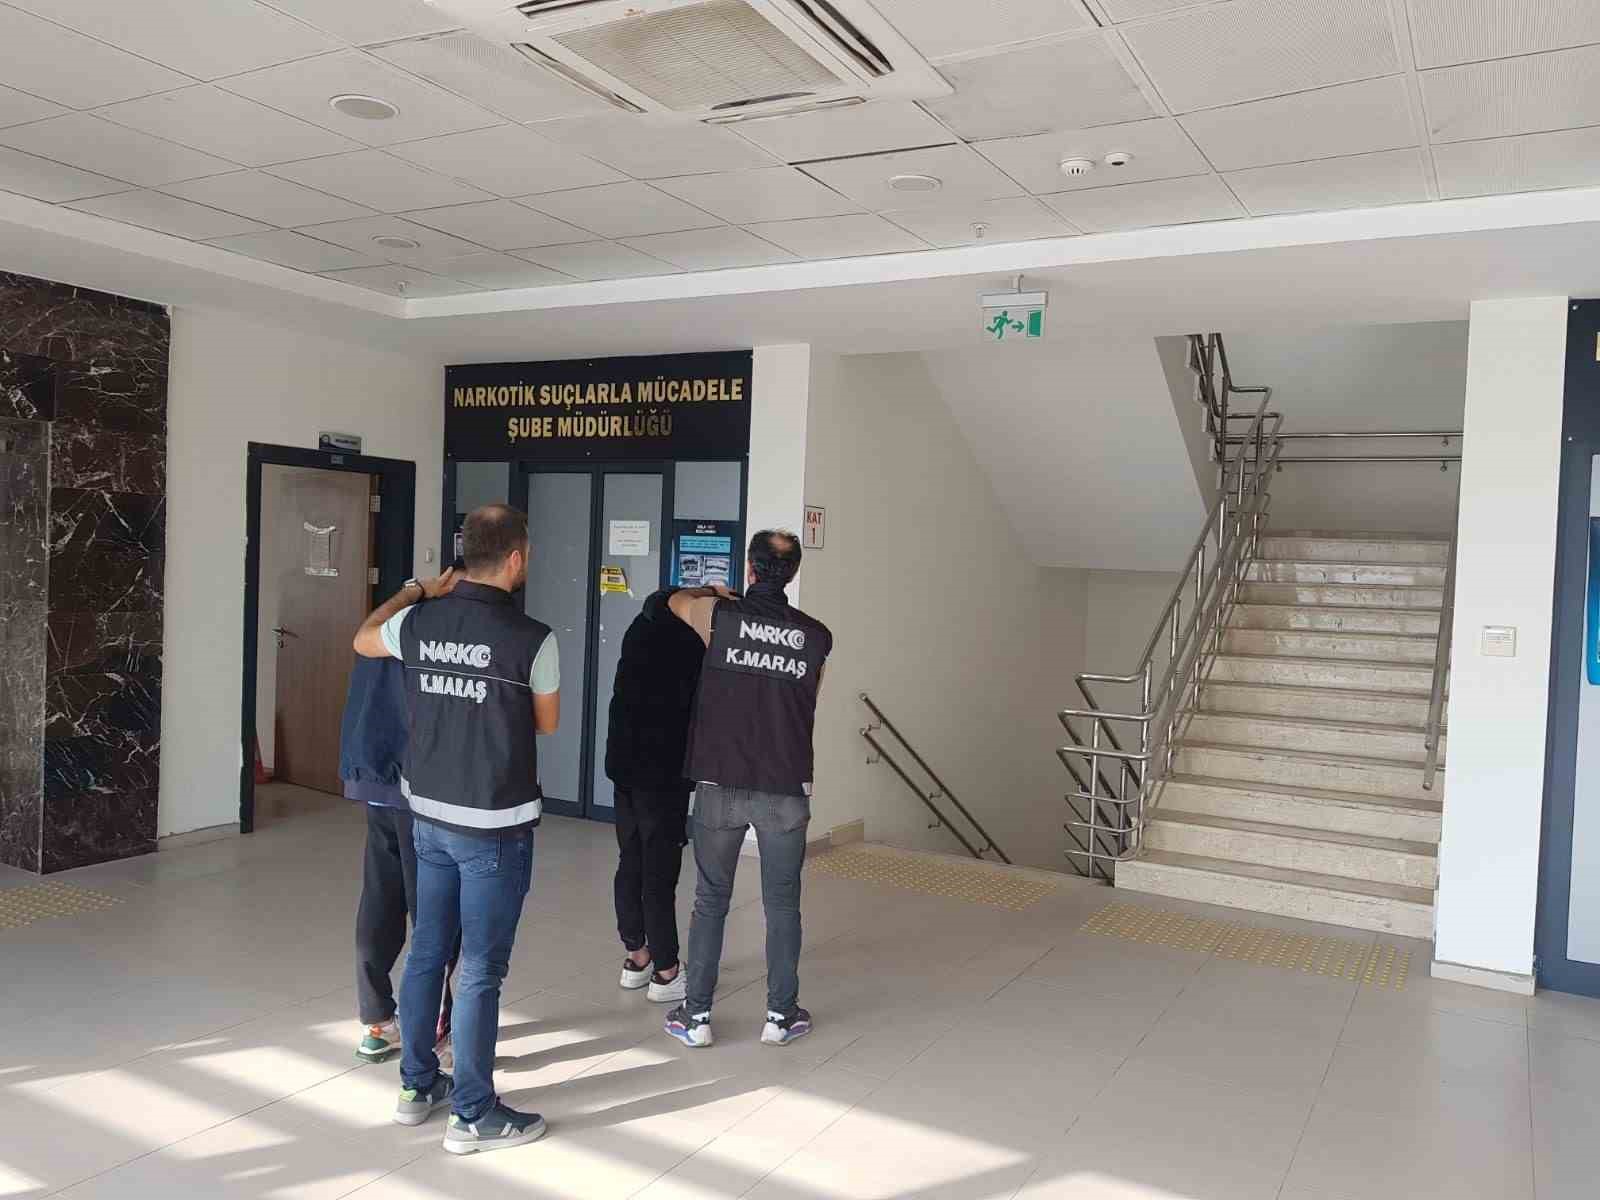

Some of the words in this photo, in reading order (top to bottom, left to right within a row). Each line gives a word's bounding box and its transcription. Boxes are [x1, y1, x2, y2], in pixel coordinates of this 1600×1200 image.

[453, 381, 536, 408] NARKOTİK
[539, 384, 632, 410] SUÇLARLA
[638, 376, 744, 402] MÜCADELE
[508, 416, 553, 443] ŞUBE
[558, 409, 673, 437] MÜDÜRLÜĞÜ
[806, 511, 823, 525] KAT
[726, 647, 807, 679] K.MARAŞ
[419, 673, 487, 704] K.MARAŞ
